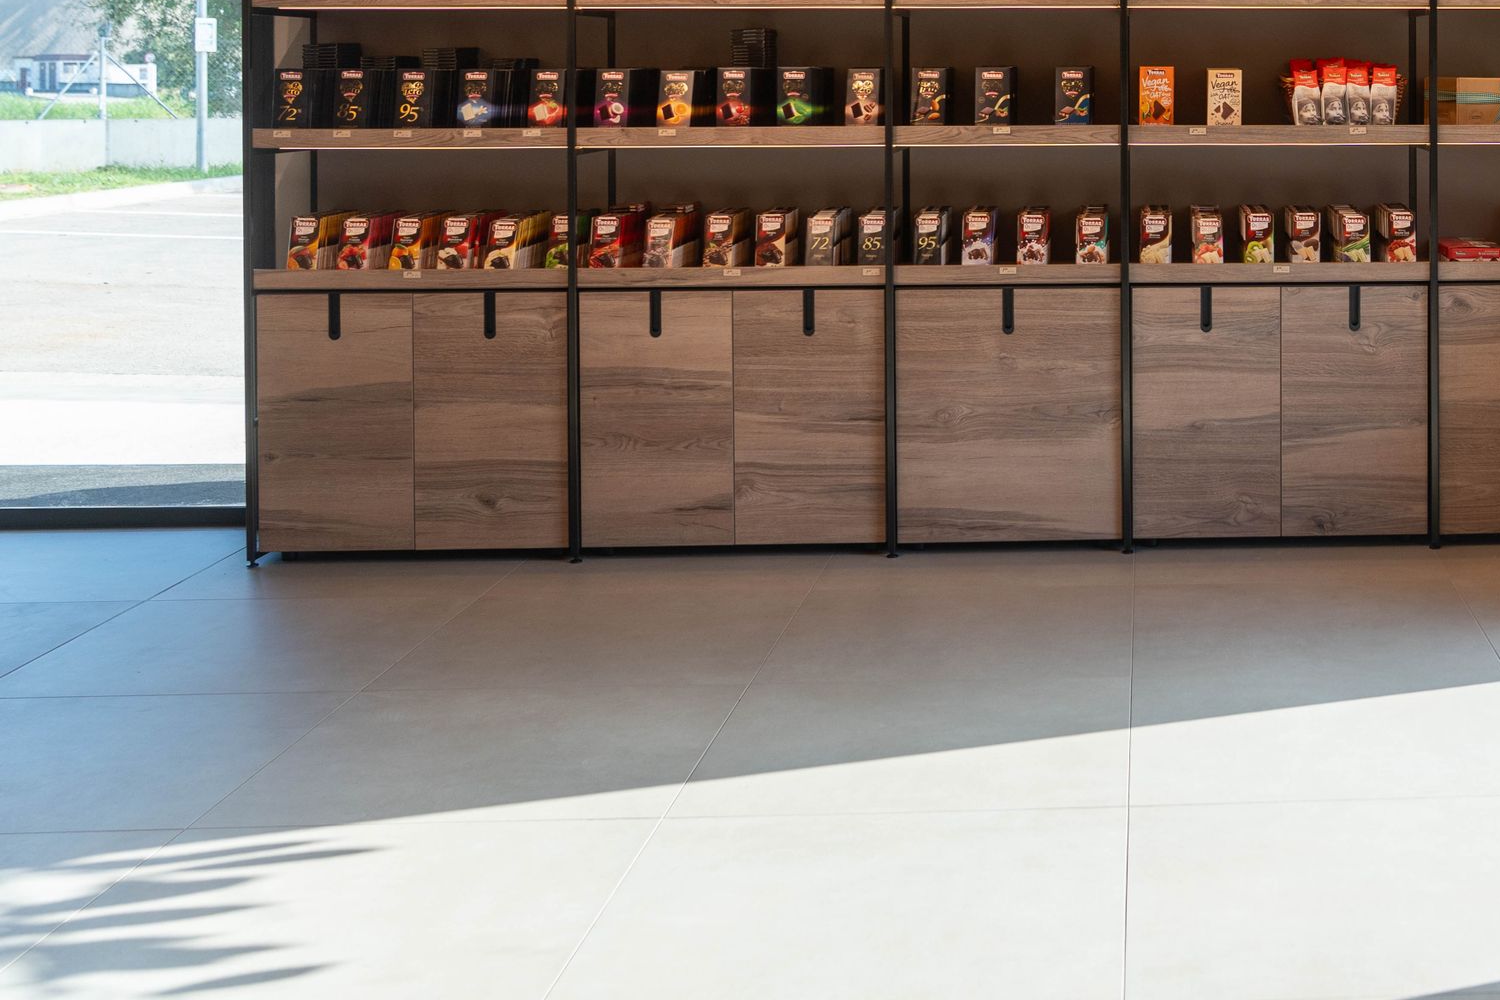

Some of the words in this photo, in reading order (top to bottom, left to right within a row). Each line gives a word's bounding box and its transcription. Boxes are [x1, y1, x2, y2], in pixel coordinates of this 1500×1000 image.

[1211, 80, 1238, 92] Vegan
[810, 236, 829, 250] 72
[863, 237, 881, 250] 85
[918, 236, 937, 250] 95
